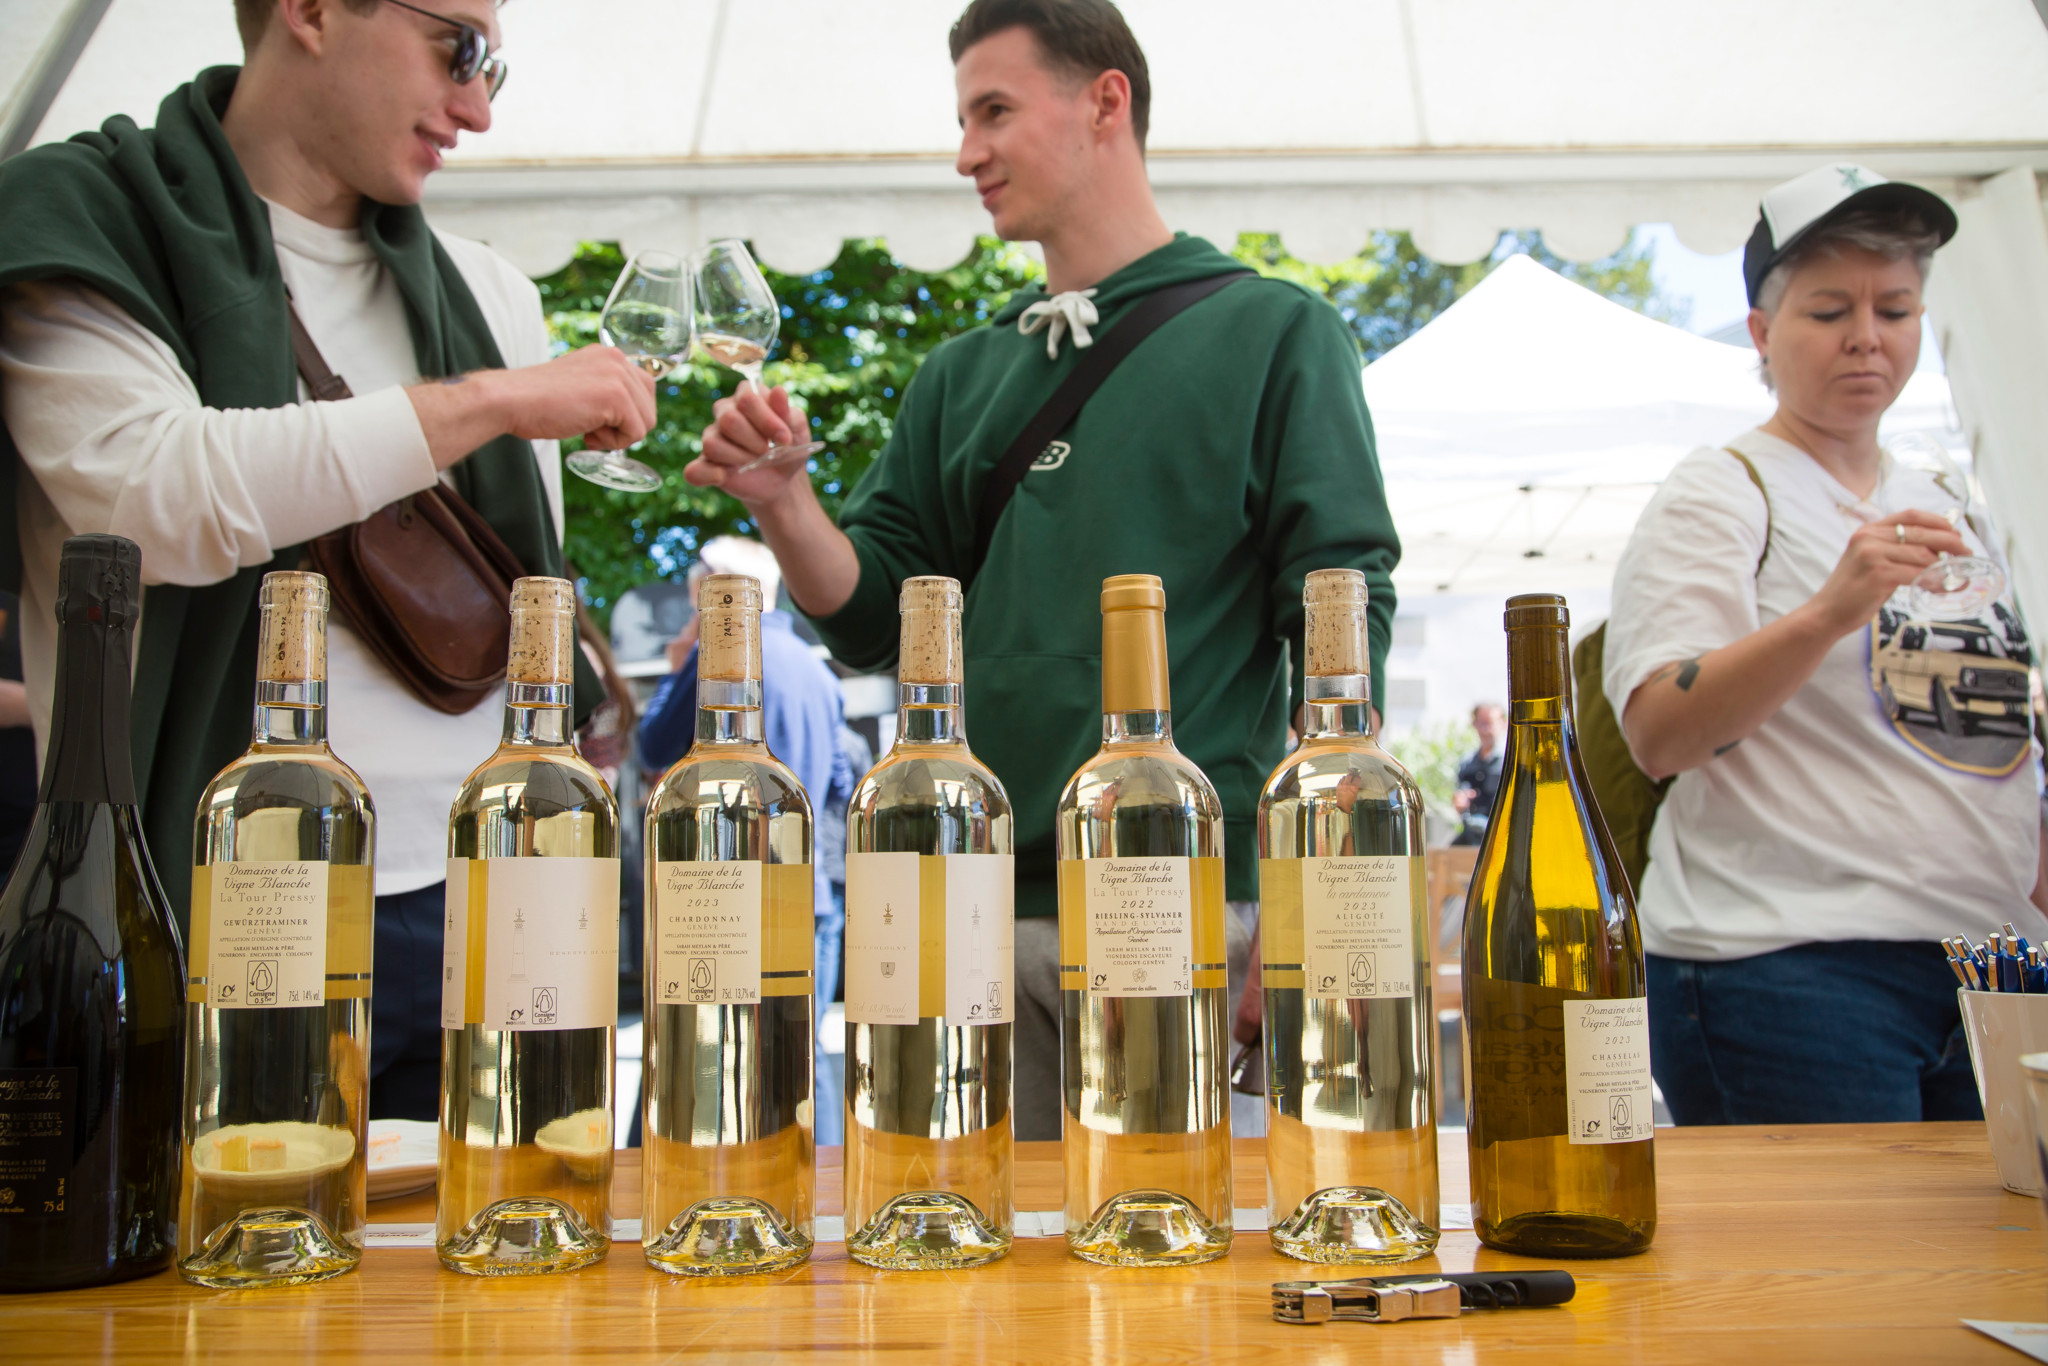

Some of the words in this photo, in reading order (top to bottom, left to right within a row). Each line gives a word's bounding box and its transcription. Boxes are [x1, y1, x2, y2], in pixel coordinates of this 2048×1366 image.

[724, 617, 732, 636] 24.15
[229, 864, 277, 875] Domaine
[281, 864, 295, 874] de
[297, 864, 308, 874] la
[1104, 862, 1146, 872] Domaine
[1149, 862, 1160, 871] de
[1163, 861, 1171, 871] la
[1321, 860, 1369, 870] Domaine
[1372, 860, 1383, 869] de
[1386, 860, 1395, 869] la
[671, 866, 713, 877] Domaine
[716, 865, 729, 876] de
[732, 865, 742, 876] la
[1101, 873, 1127, 887] Vigne
[1131, 873, 1173, 883] Blanche
[1318, 872, 1349, 887] Vigne
[1353, 871, 1397, 883] Blanche
[224, 878, 254, 893] Vigne
[258, 877, 311, 888] Blanche
[667, 879, 693, 893] Vigne
[697, 879, 744, 889] Blanche
[220, 893, 232, 902] La
[239, 893, 267, 902] Tour
[275, 892, 316, 903] Pressy
[1094, 888, 1105, 897] La
[1112, 888, 1139, 897] Tour
[1147, 887, 1185, 898] Pressy
[1326, 887, 1336, 899] la
[687, 899, 719, 907] 2023
[1122, 900, 1154, 908] 2022
[247, 907, 282, 915] 2023
[1095, 928, 1126, 936] Appellation
[1173, 981, 1181, 991] 75
[1585, 1004, 1625, 1015] Domaine
[1627, 1004, 1635, 1013] de
[1636, 1002, 1642, 1013] la
[1580, 1017, 1609, 1032] Vigne
[1613, 1015, 1644, 1028] Blanche
[1605, 1036, 1631, 1045] 2023
[1592, 1053, 1640, 1061] CHASSELAS
[5, 1088, 61, 1100] Blanche
[44, 1201, 54, 1212] 75
